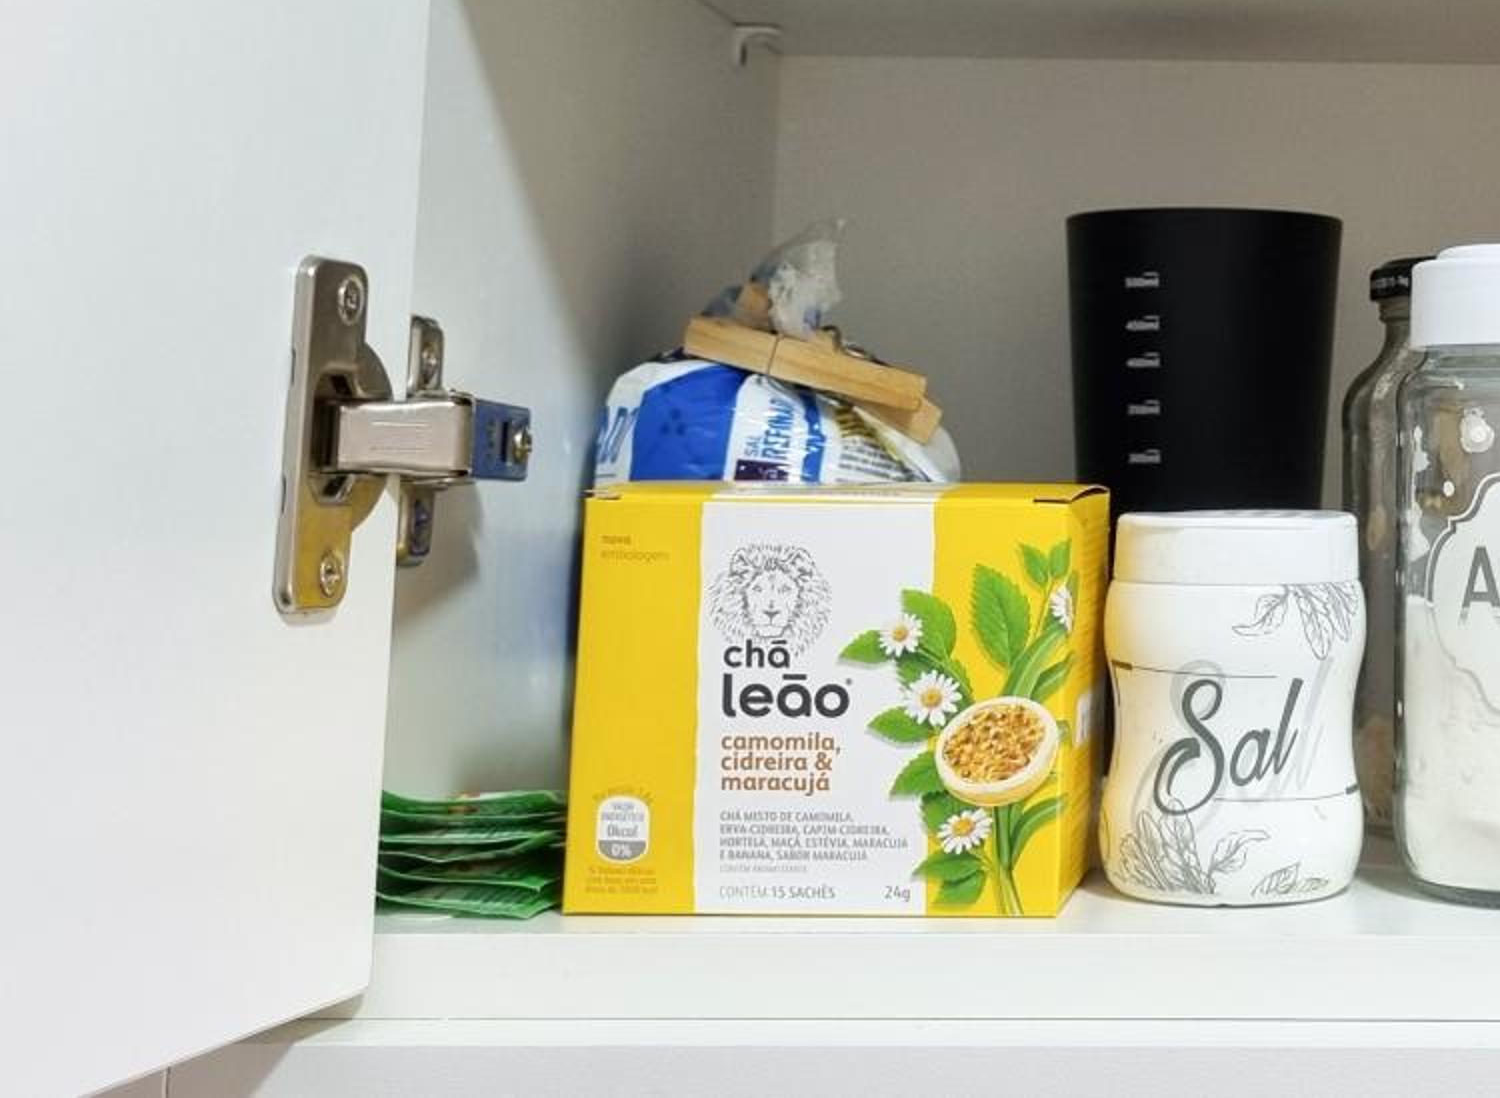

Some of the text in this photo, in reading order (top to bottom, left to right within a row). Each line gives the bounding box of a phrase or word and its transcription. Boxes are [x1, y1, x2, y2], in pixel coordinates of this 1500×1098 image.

[721, 732, 841, 755] camomila,
[1153, 677, 1304, 816] Sal
[721, 752, 832, 771] cidreira &
[721, 773, 831, 797] maracujá
[743, 810, 779, 822] MISTO
[780, 811, 794, 822] DE
[611, 843, 633, 858] 0%
[772, 885, 786, 899] 15
[788, 882, 836, 900] SACHÊS
[884, 885, 911, 902] 24g
